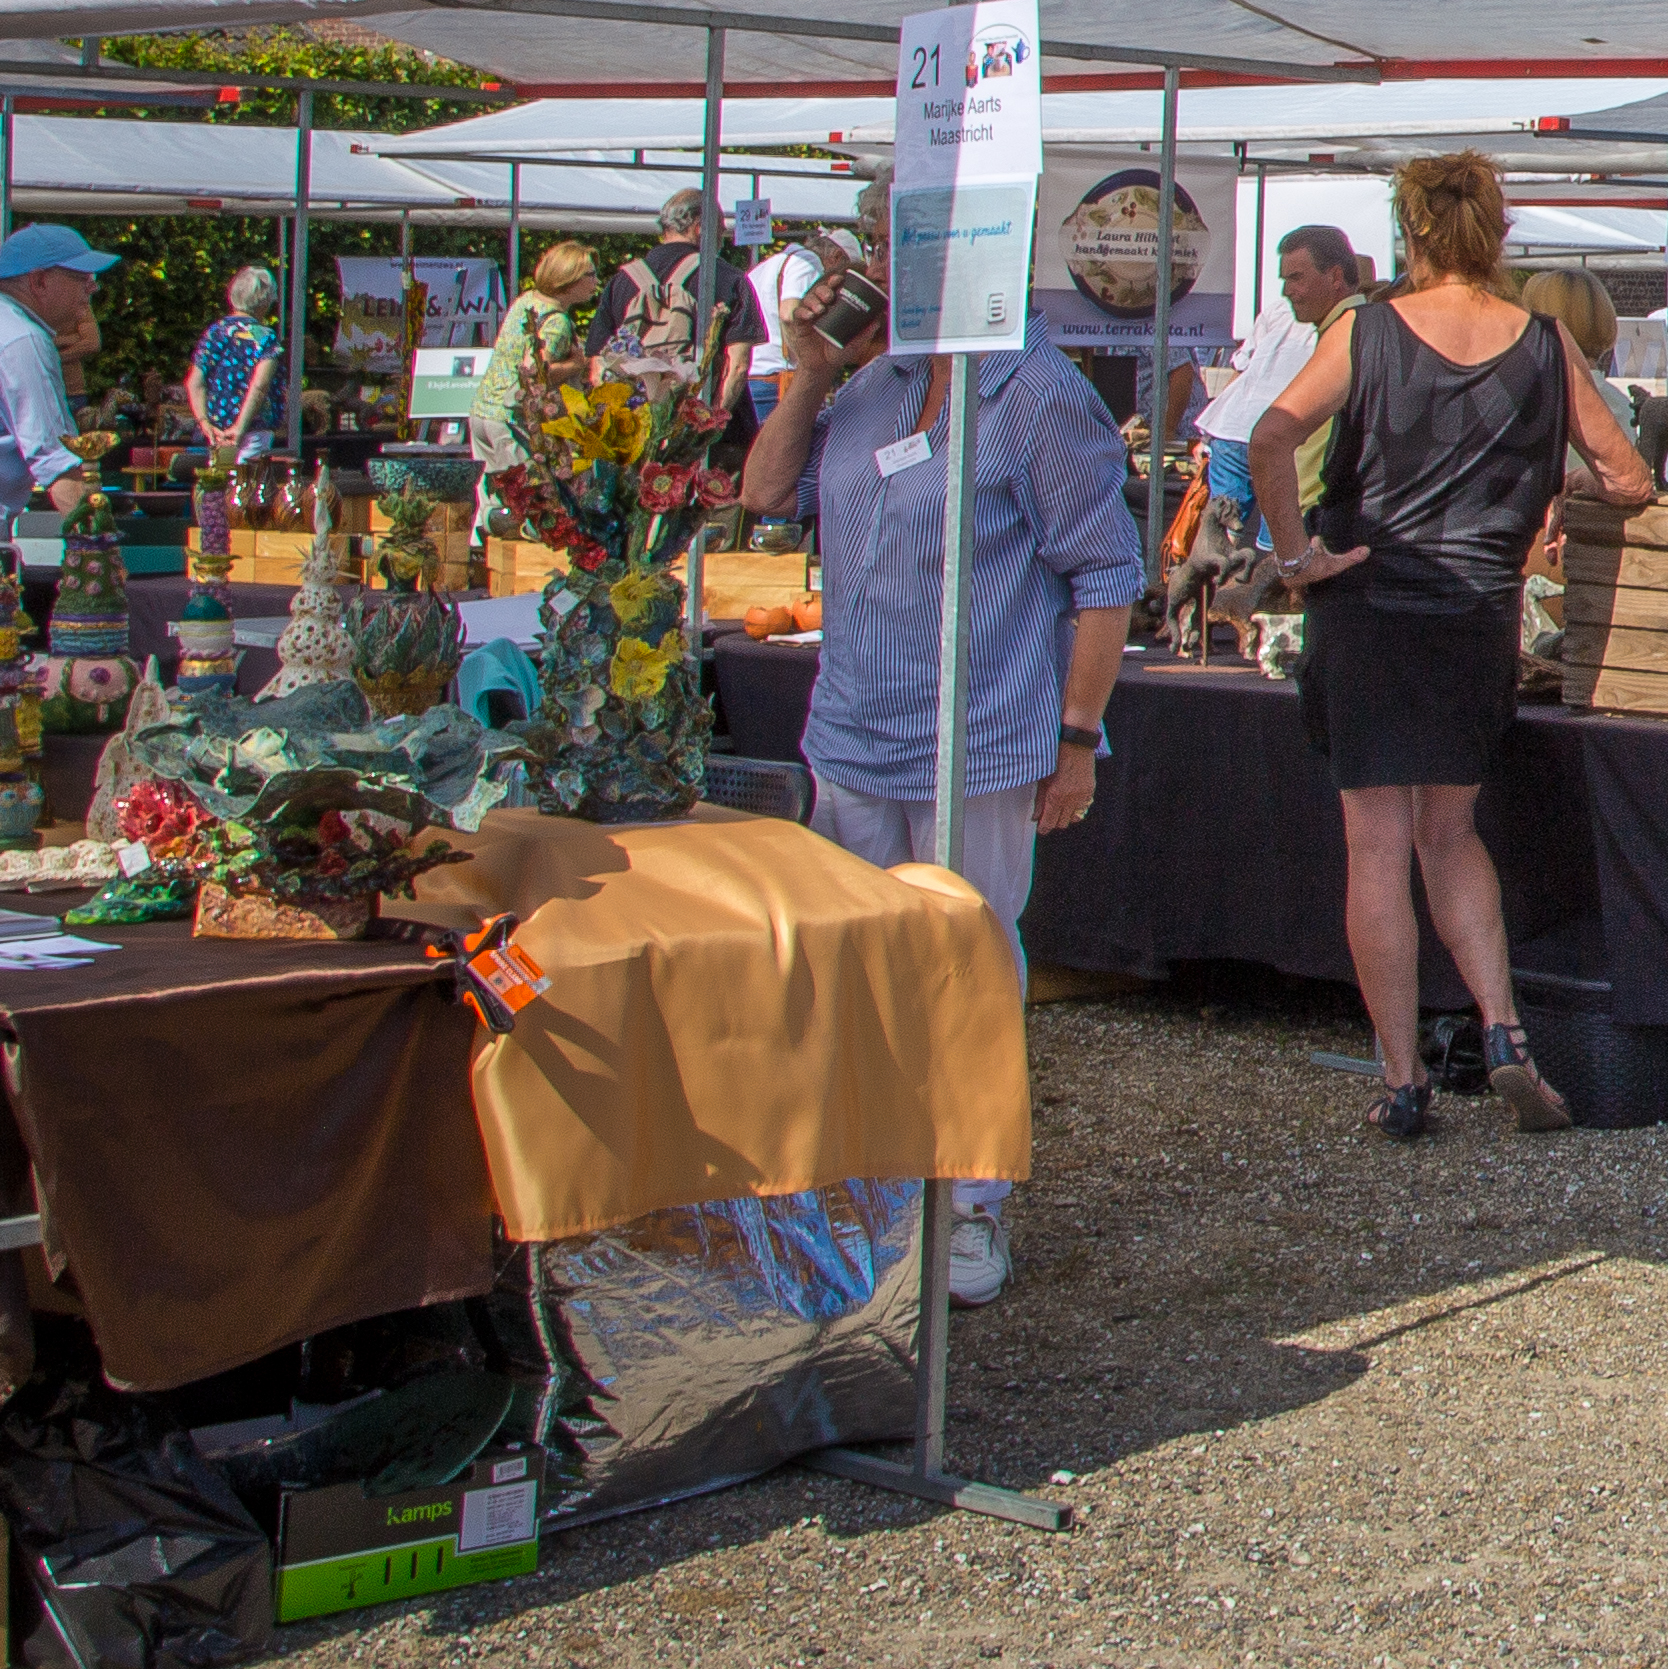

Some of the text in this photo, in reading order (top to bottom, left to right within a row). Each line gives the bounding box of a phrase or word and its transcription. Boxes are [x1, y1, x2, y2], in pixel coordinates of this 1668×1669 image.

[911, 43, 941, 89] 21
[924, 96, 1002, 122] Marijke Aarts
[930, 124, 994, 147] Maastricht
